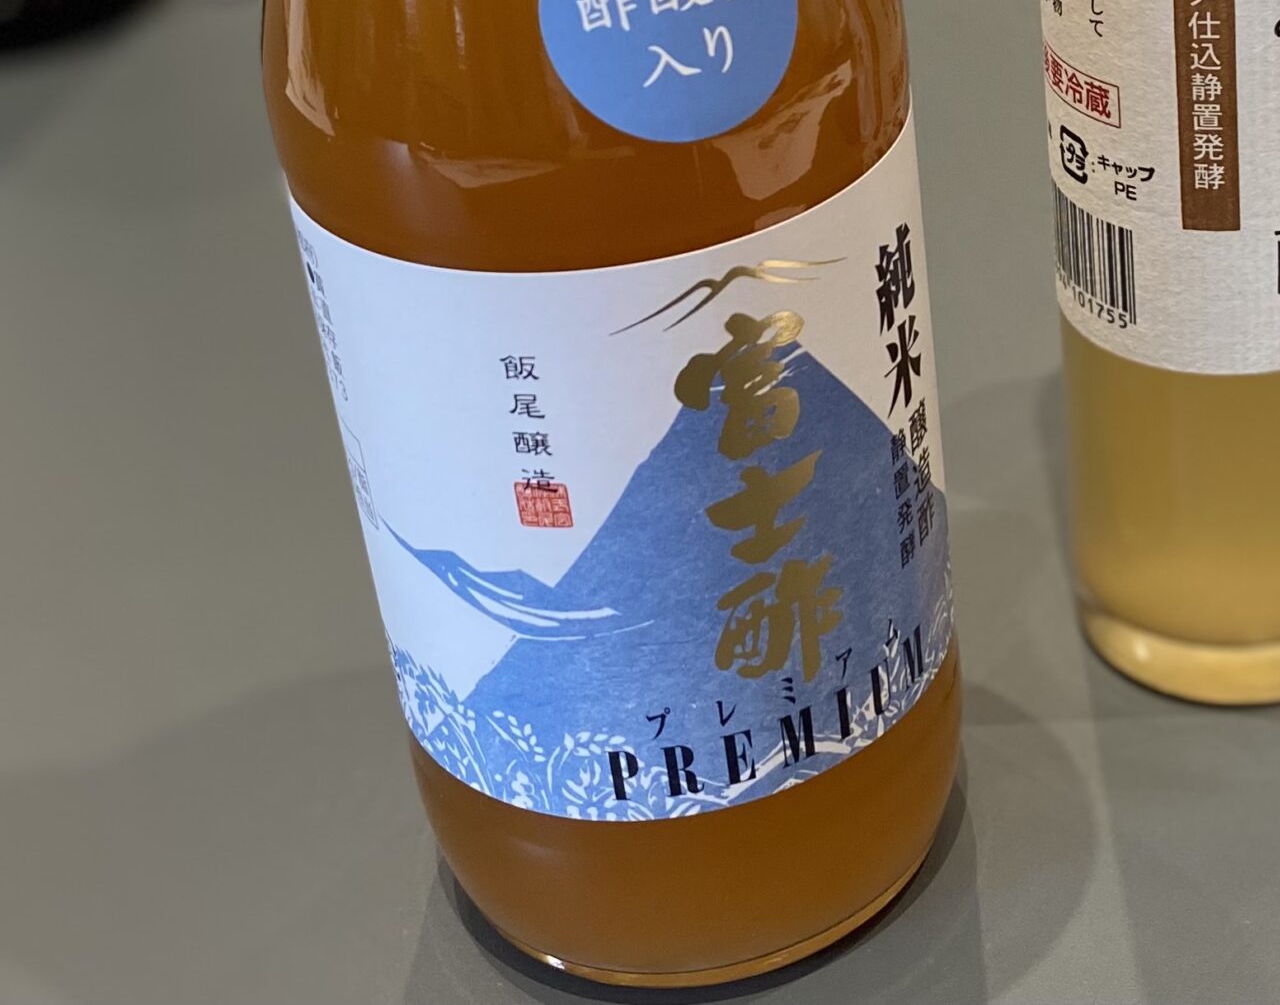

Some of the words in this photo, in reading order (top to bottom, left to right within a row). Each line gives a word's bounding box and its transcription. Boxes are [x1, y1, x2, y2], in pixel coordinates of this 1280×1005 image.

[642, 24, 734, 88] 入り
[1113, 180, 1138, 201] PE
[874, 222, 922, 420] 純米
[498, 354, 560, 493] 飯尾醸造
[673, 308, 845, 684] 富士酢
[606, 623, 926, 802] PREMIUM
[645, 617, 900, 741] プレミアム
